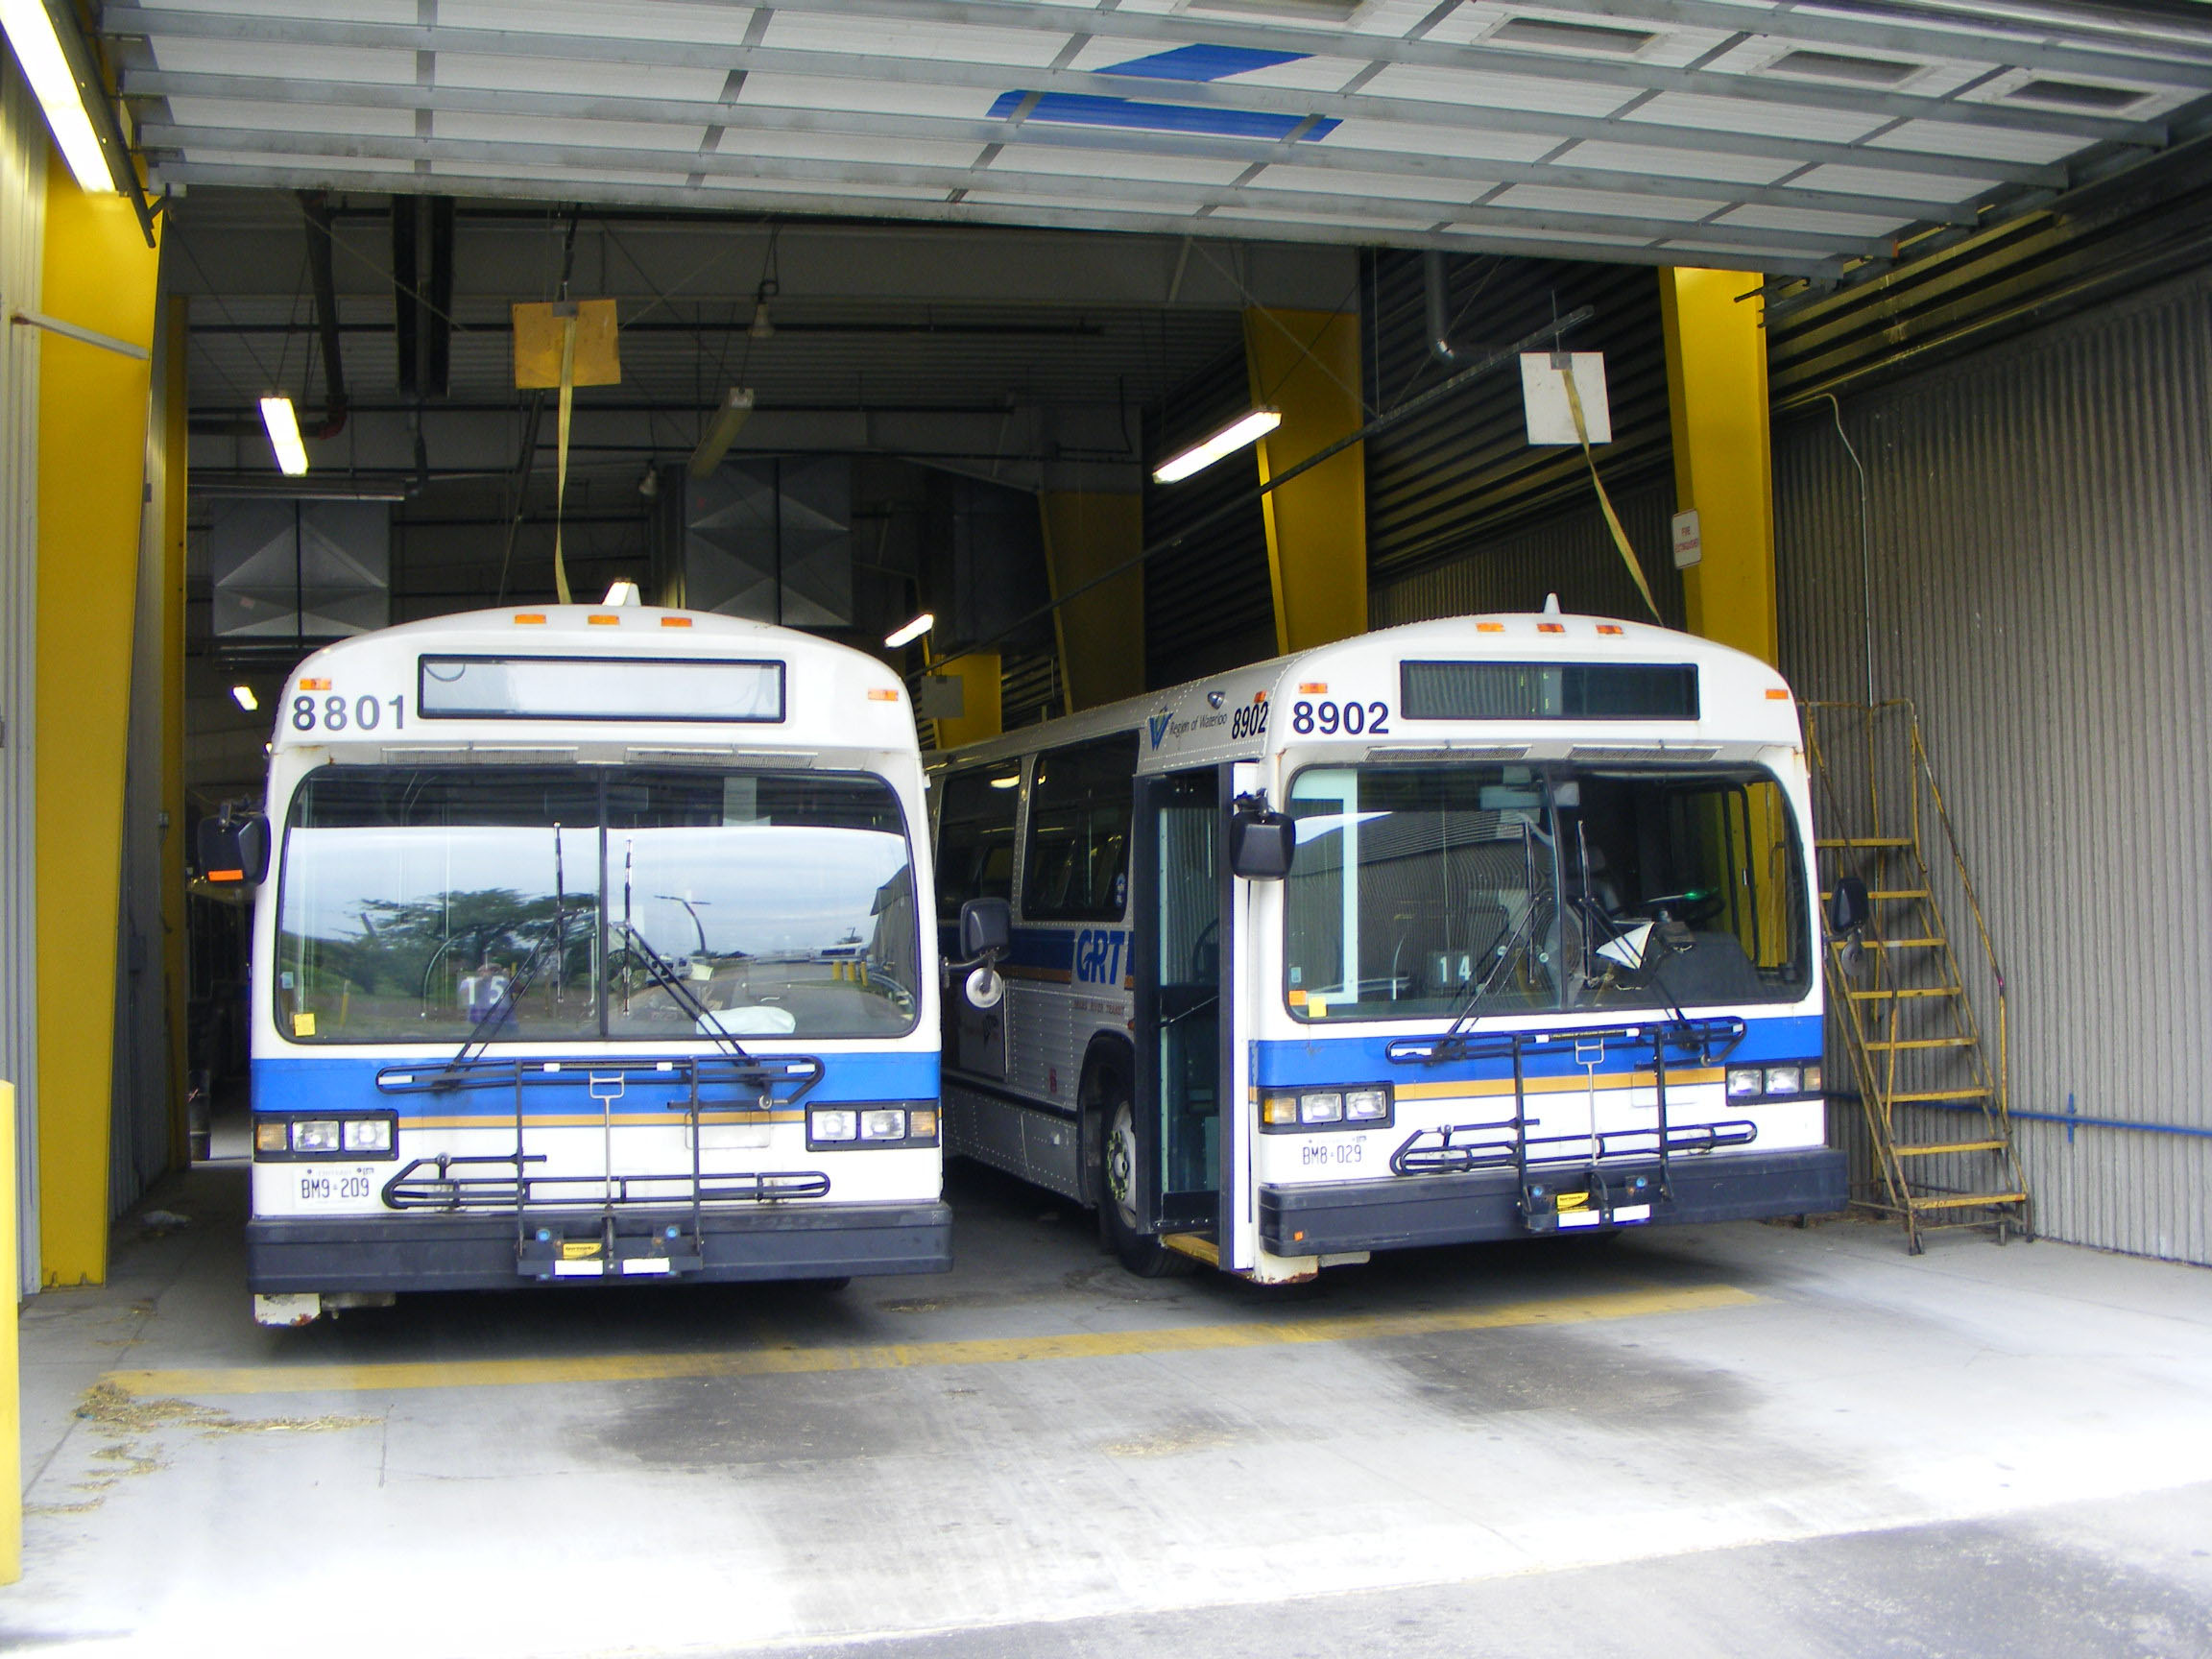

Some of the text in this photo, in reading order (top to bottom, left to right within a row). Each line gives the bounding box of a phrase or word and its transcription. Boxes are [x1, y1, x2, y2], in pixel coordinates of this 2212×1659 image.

[293, 695, 403, 731] 8801
[1232, 701, 1268, 739] 8902
[1293, 701, 1389, 734] 8902
[1076, 928, 1125, 985] GRT
